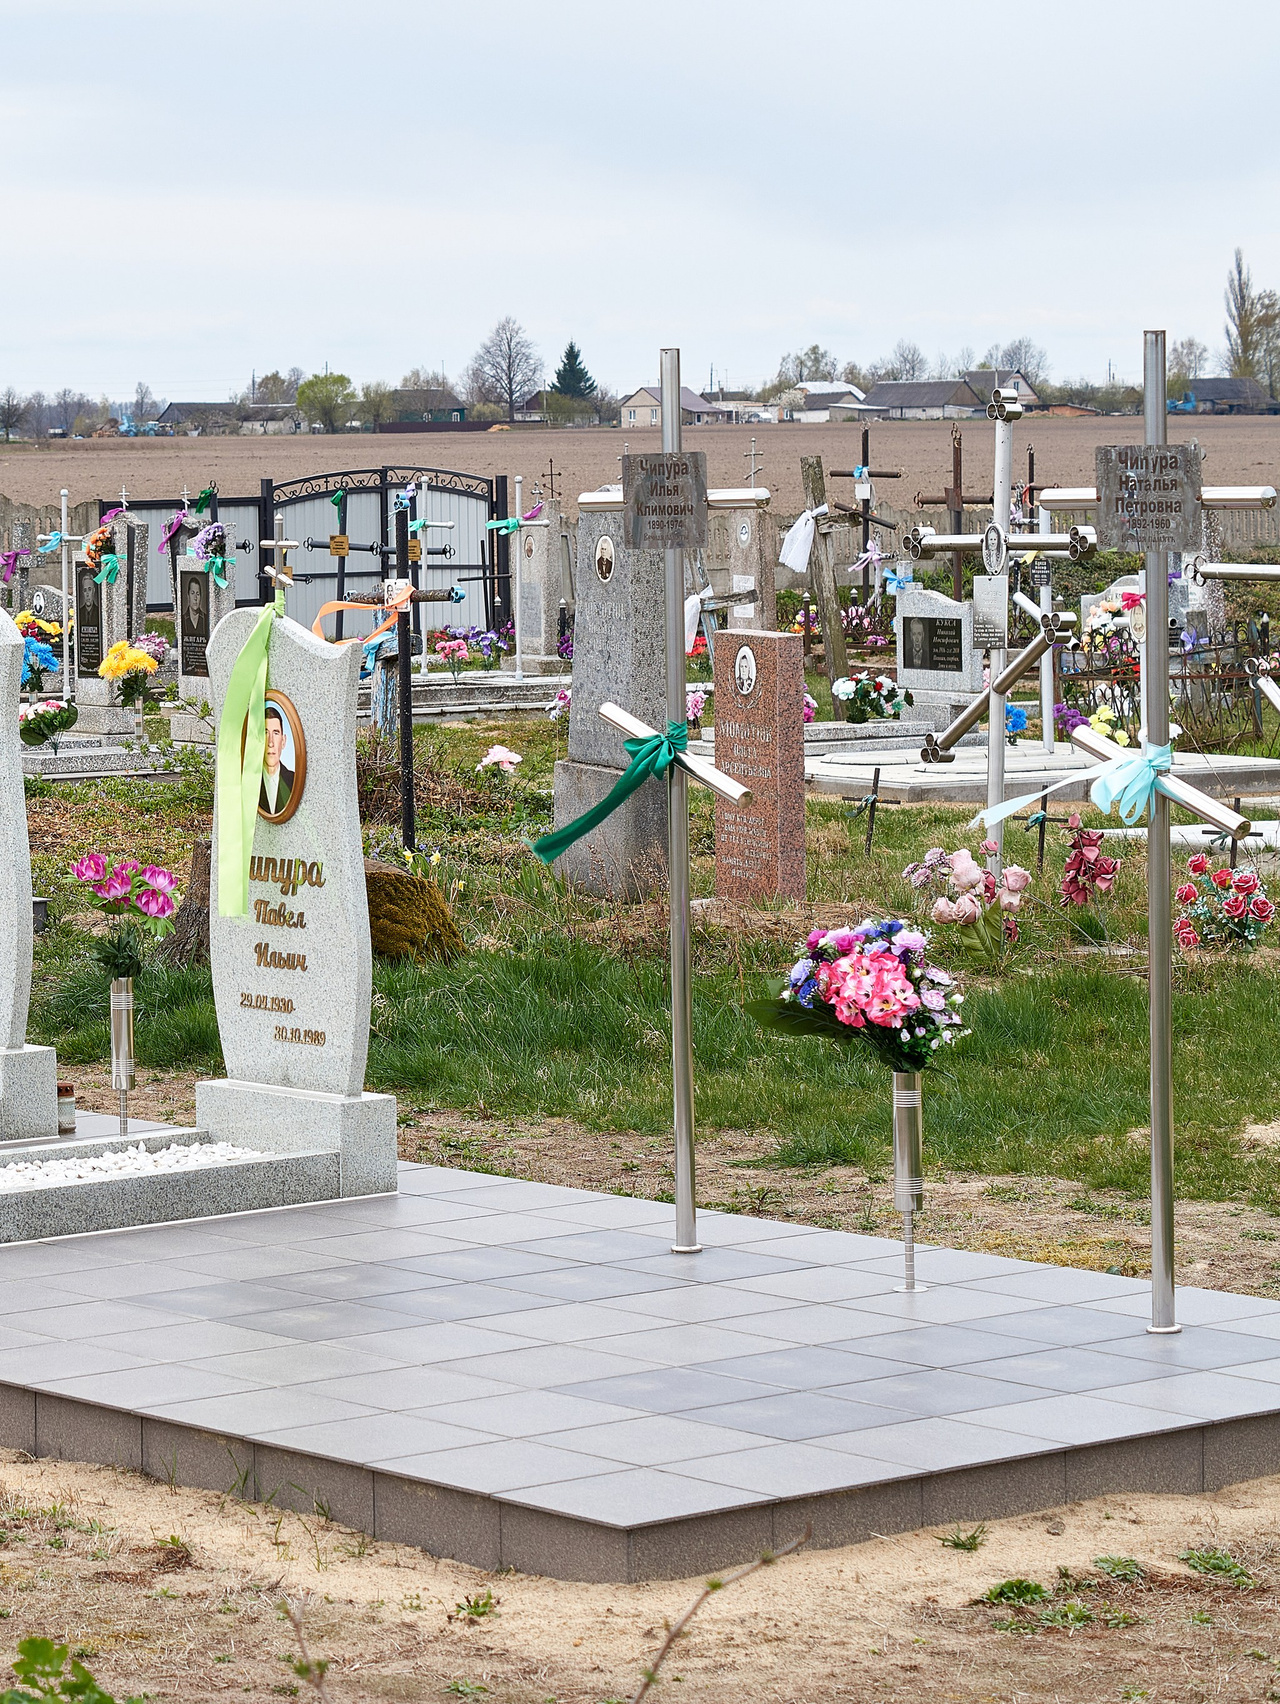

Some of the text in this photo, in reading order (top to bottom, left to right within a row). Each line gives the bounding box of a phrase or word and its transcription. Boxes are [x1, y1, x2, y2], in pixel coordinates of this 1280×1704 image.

[640, 459, 689, 480] Чипура
[1118, 451, 1179, 474] Чипура
[650, 480, 680, 497] Илья
[1119, 475, 1178, 491] Наталья
[636, 503, 694, 517] Климович
[1115, 497, 1182, 516] Петровна
[1127, 518, 1171, 529] 1892-1960
[249, 855, 326, 896] ипура
[254, 899, 306, 929] Павел
[254, 942, 308, 971] Ильич
[274, 1025, 326, 1047] 30.10.1989
